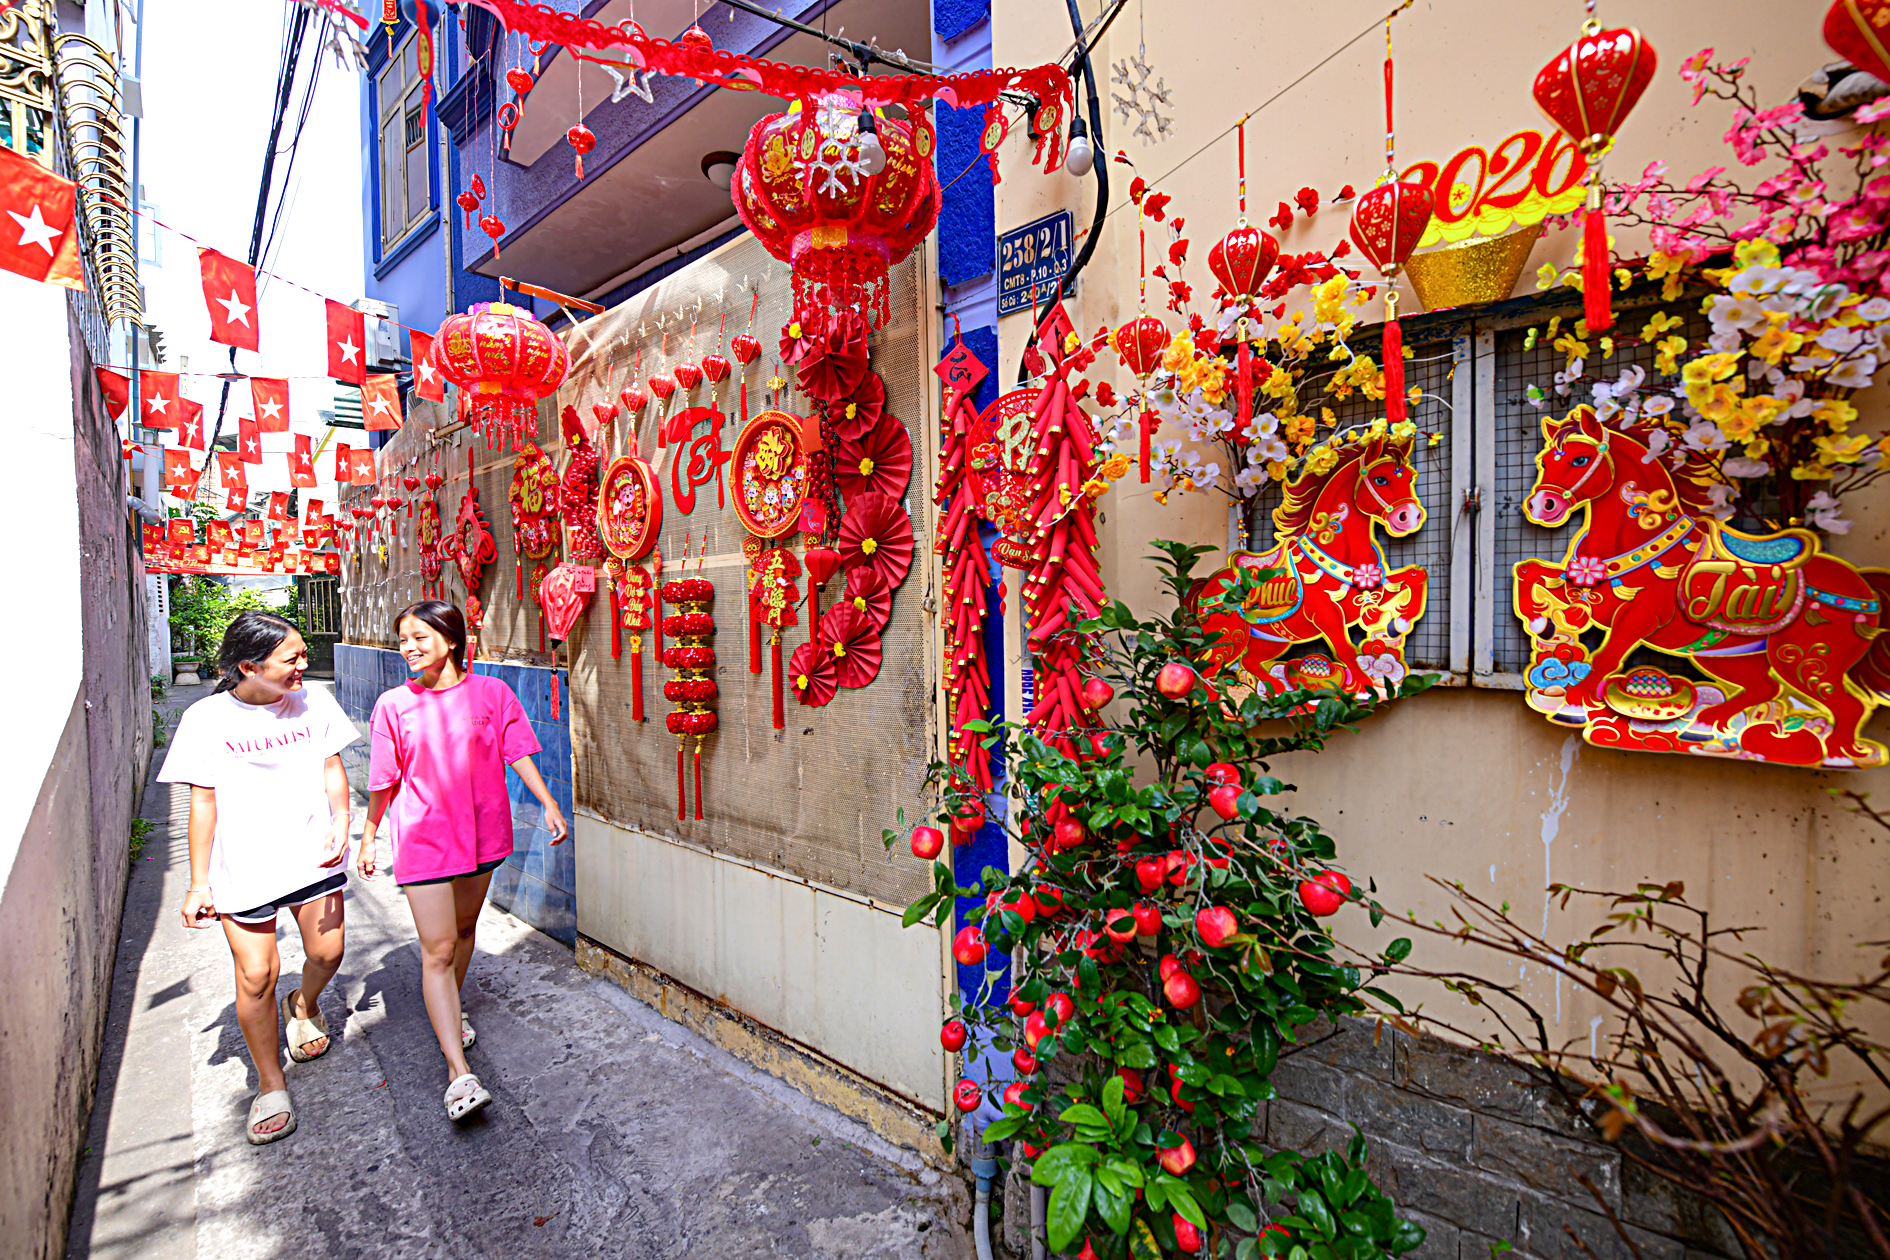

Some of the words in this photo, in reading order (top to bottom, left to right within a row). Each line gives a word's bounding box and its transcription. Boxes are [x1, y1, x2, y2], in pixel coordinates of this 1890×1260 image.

[1003, 220, 1068, 272] 258/2/1
[1004, 273, 1025, 290] CMT8
[520, 464, 543, 513] 福
[1684, 561, 1781, 620] Tài
